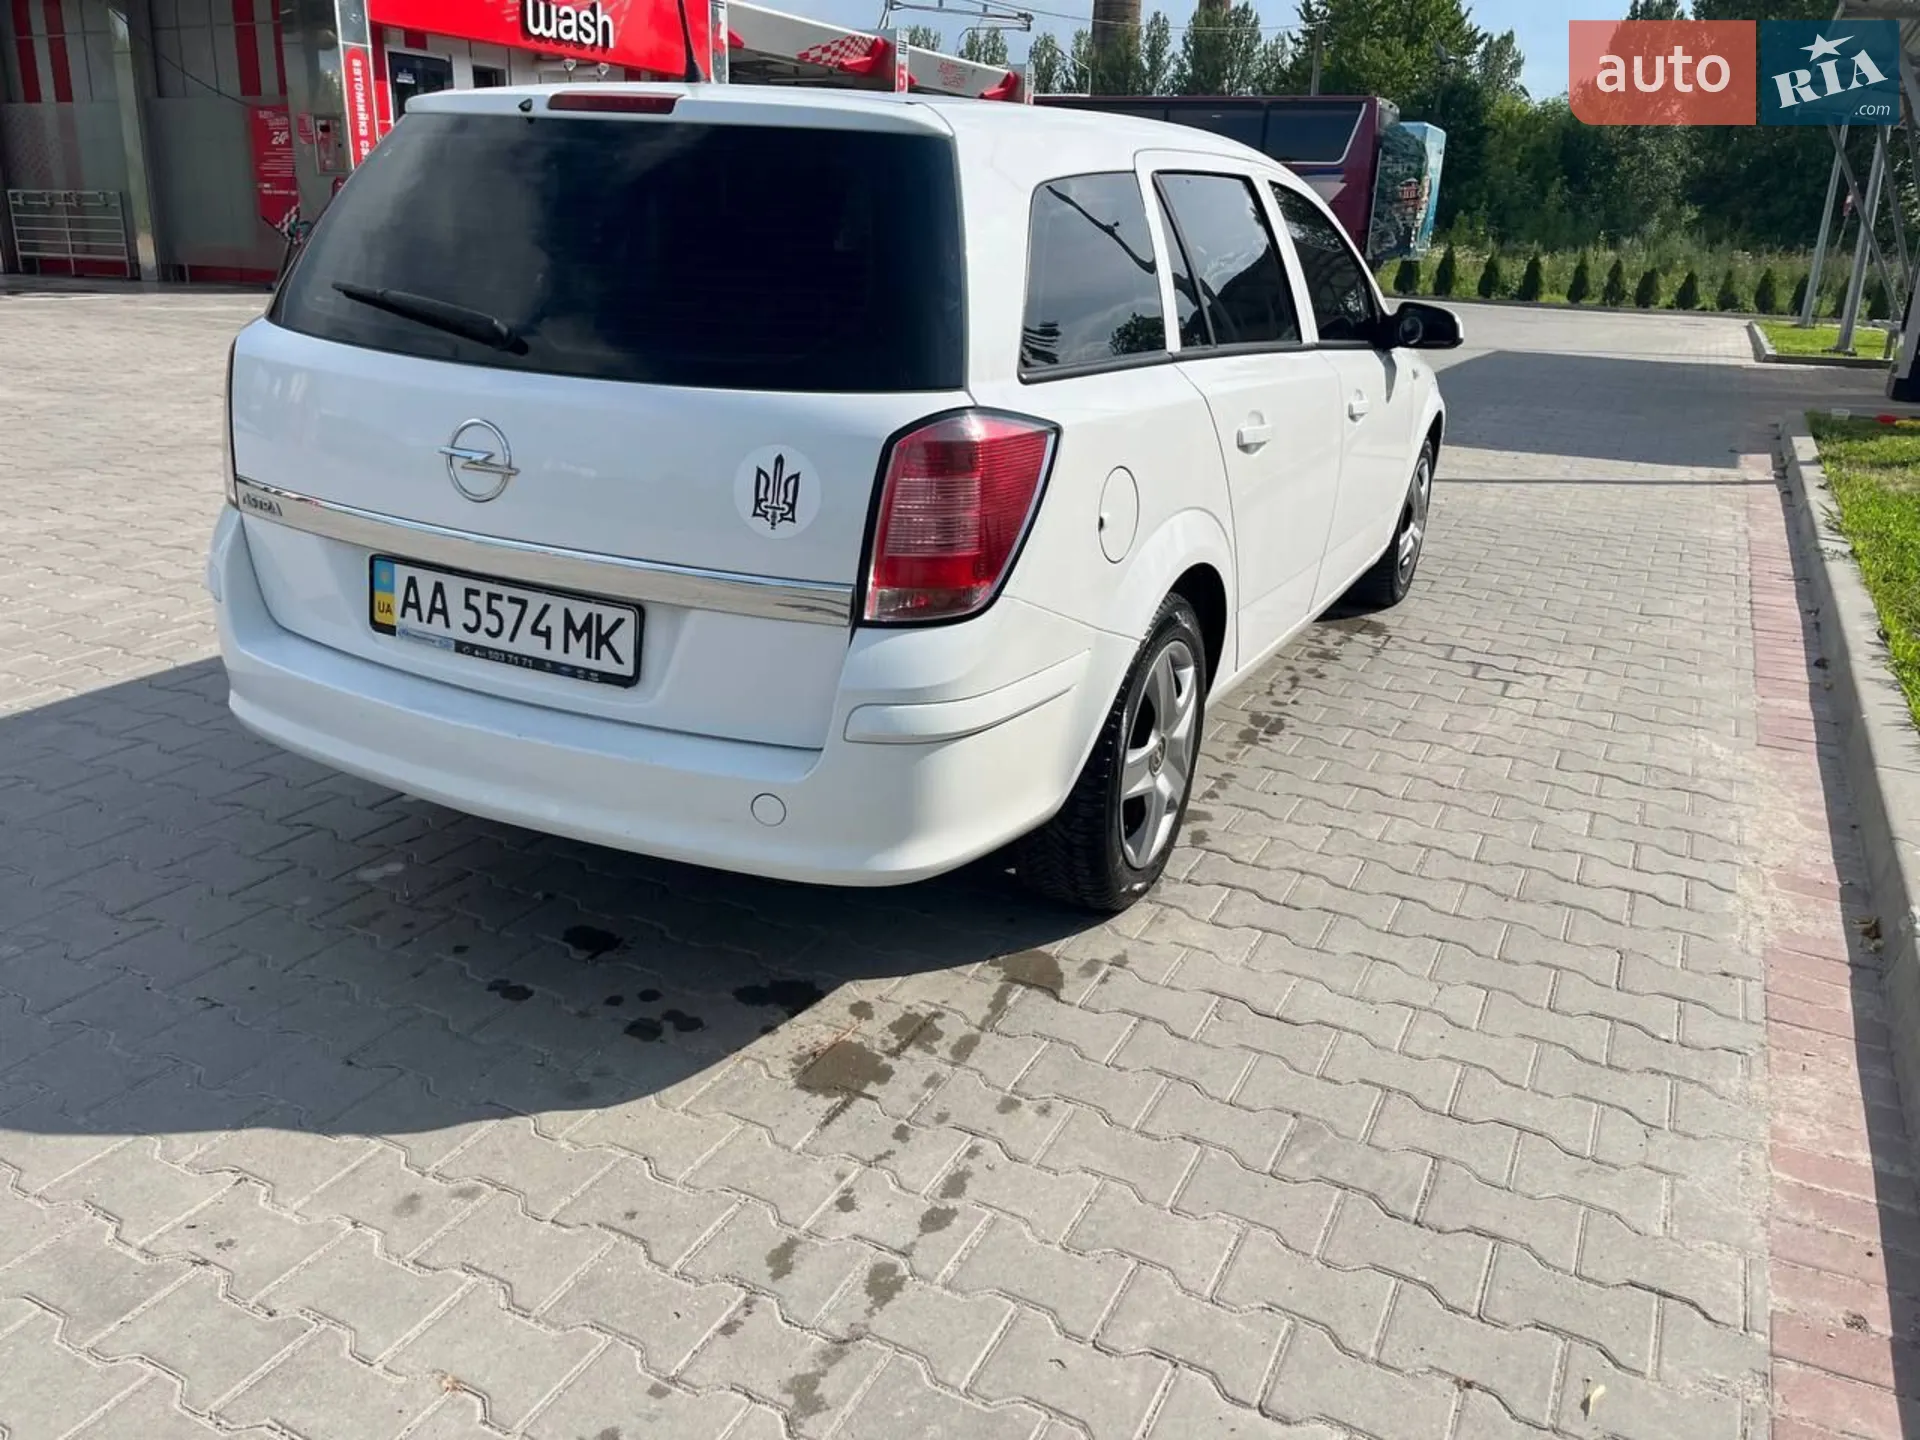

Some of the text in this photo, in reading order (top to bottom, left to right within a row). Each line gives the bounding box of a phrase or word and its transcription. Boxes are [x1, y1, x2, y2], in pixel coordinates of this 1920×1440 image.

[526, 0, 615, 49] wash
[377, 601, 394, 616] UA
[400, 575, 626, 666] AA 5574 MK
